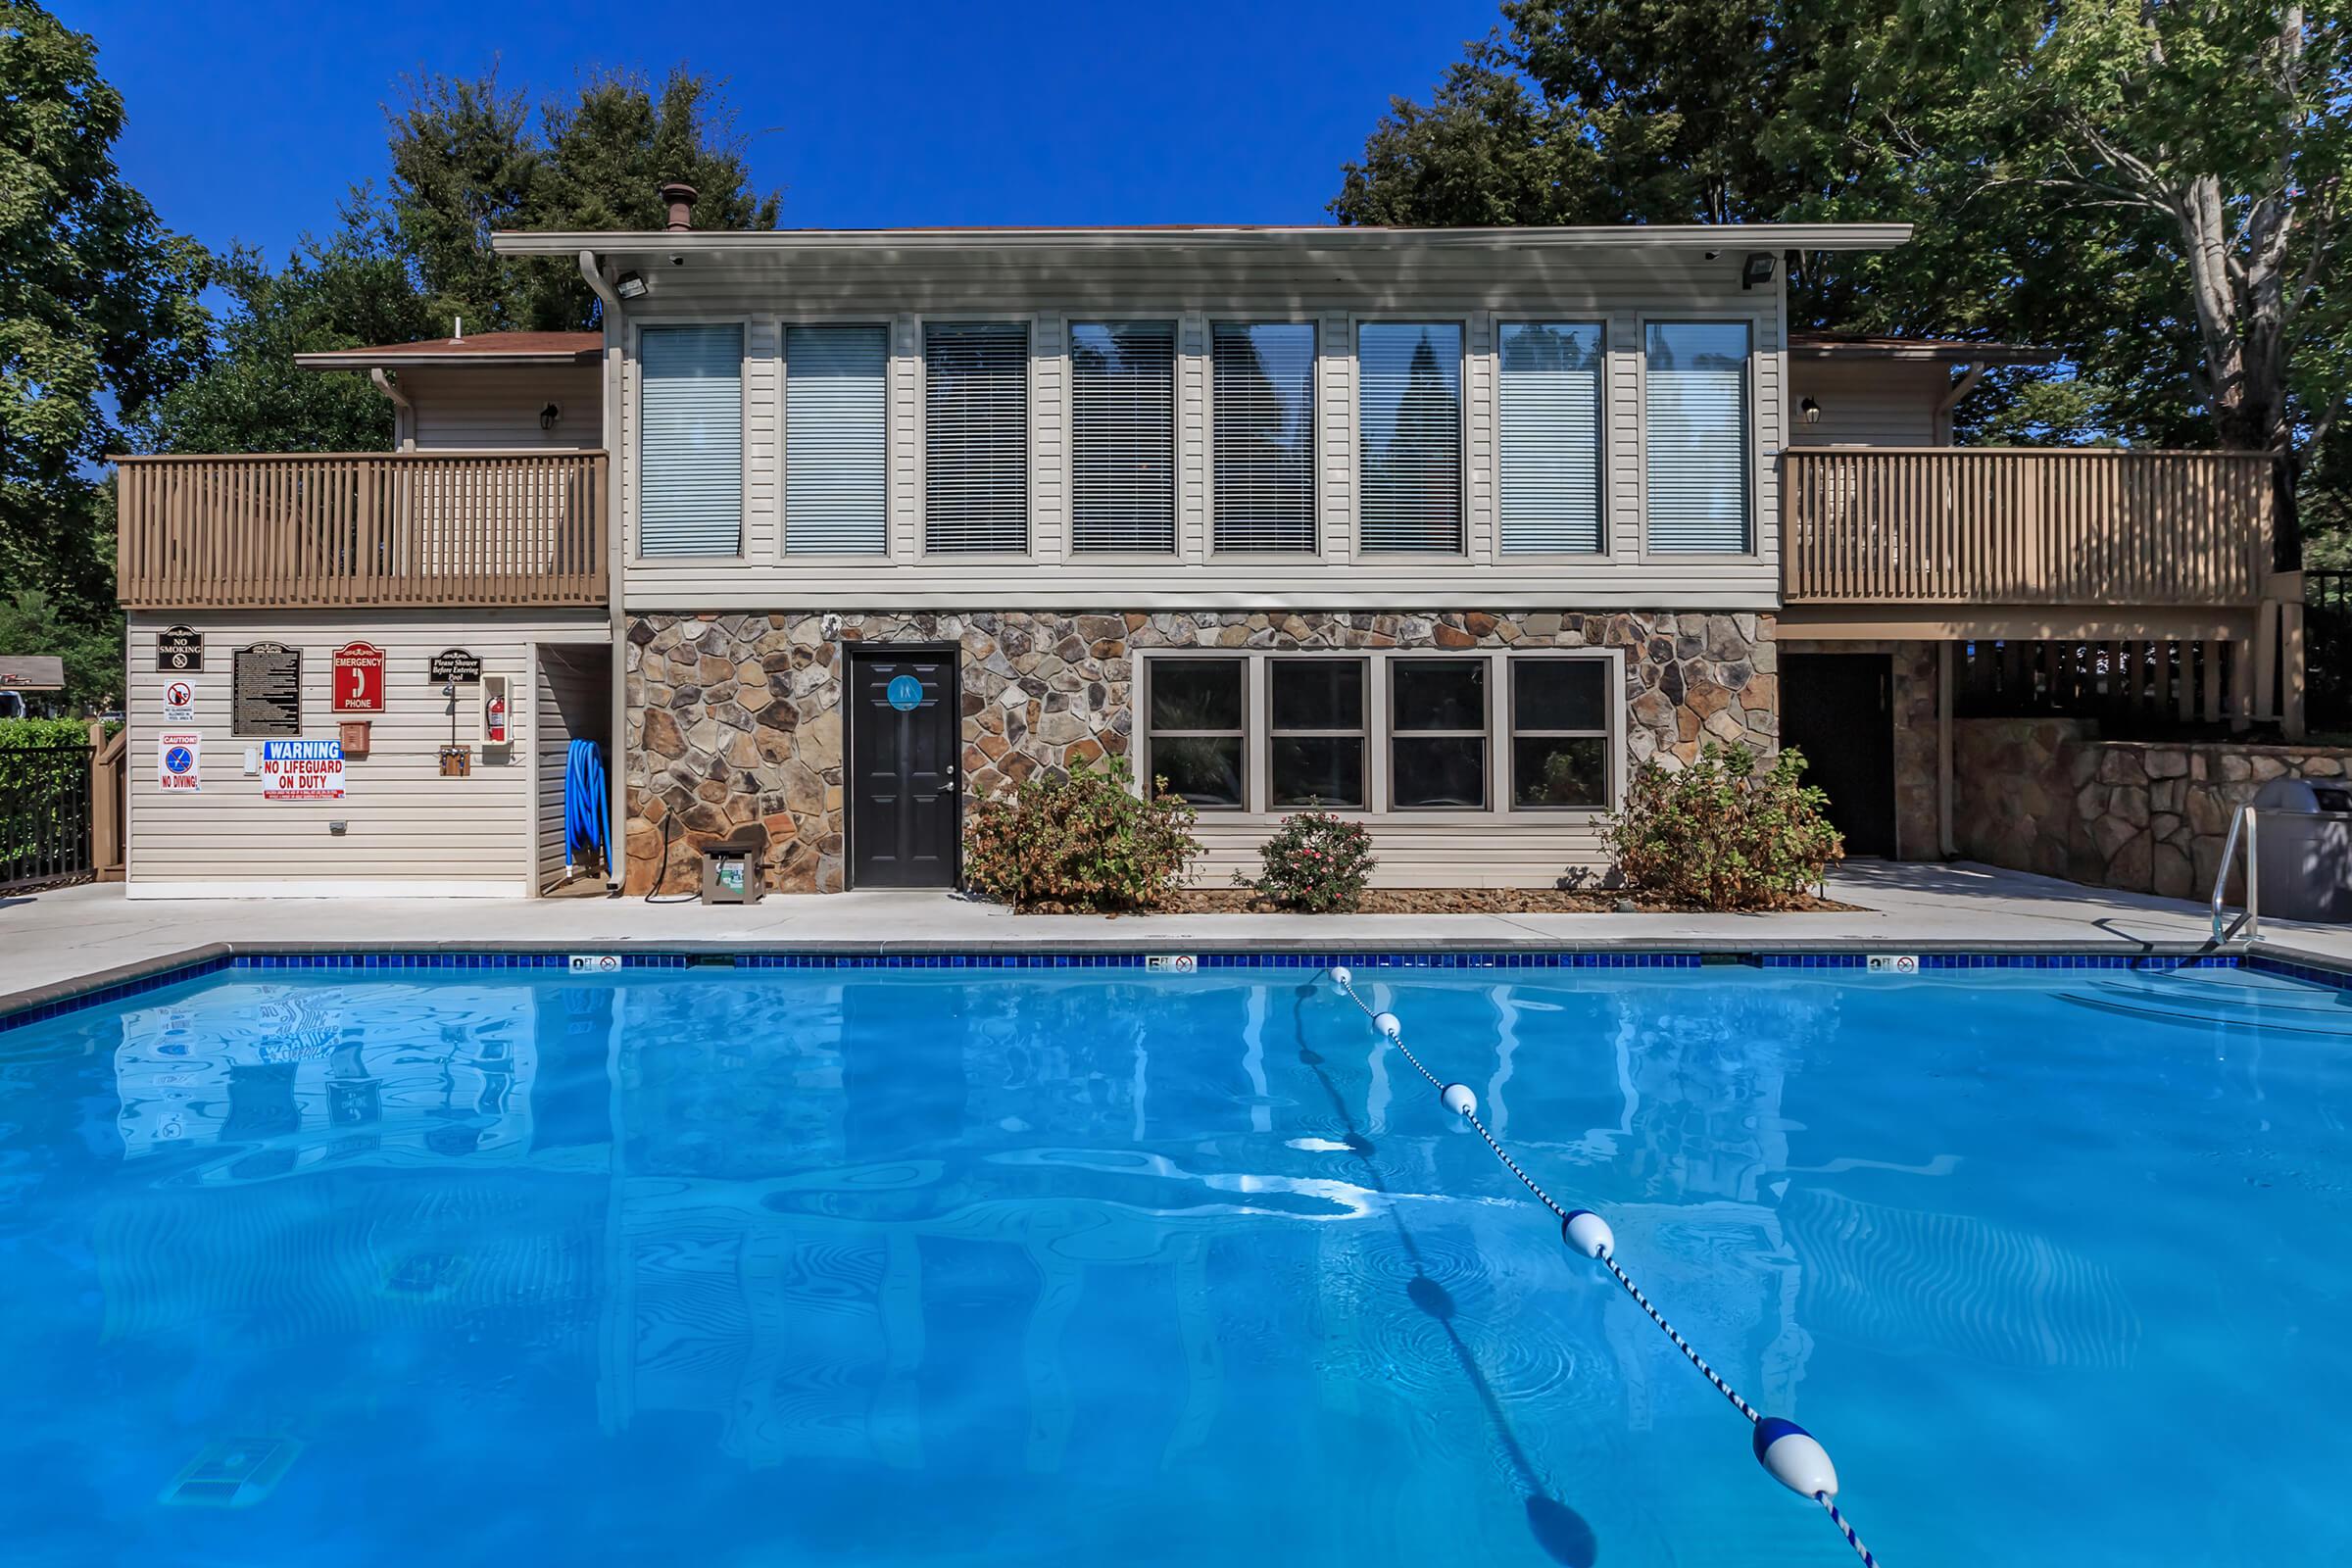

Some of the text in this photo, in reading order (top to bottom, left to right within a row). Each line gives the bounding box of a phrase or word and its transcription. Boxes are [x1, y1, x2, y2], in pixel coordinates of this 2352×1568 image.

[335, 658, 382, 666] EMERGENCY
[432, 666, 479, 675] Before Entering
[345, 699, 371, 708] PHONE
[270, 742, 339, 760] WARNING
[265, 760, 342, 774] NO LIFEGUARD
[162, 775, 198, 788] NO DIVING!
[278, 775, 327, 789] ON DUTY
